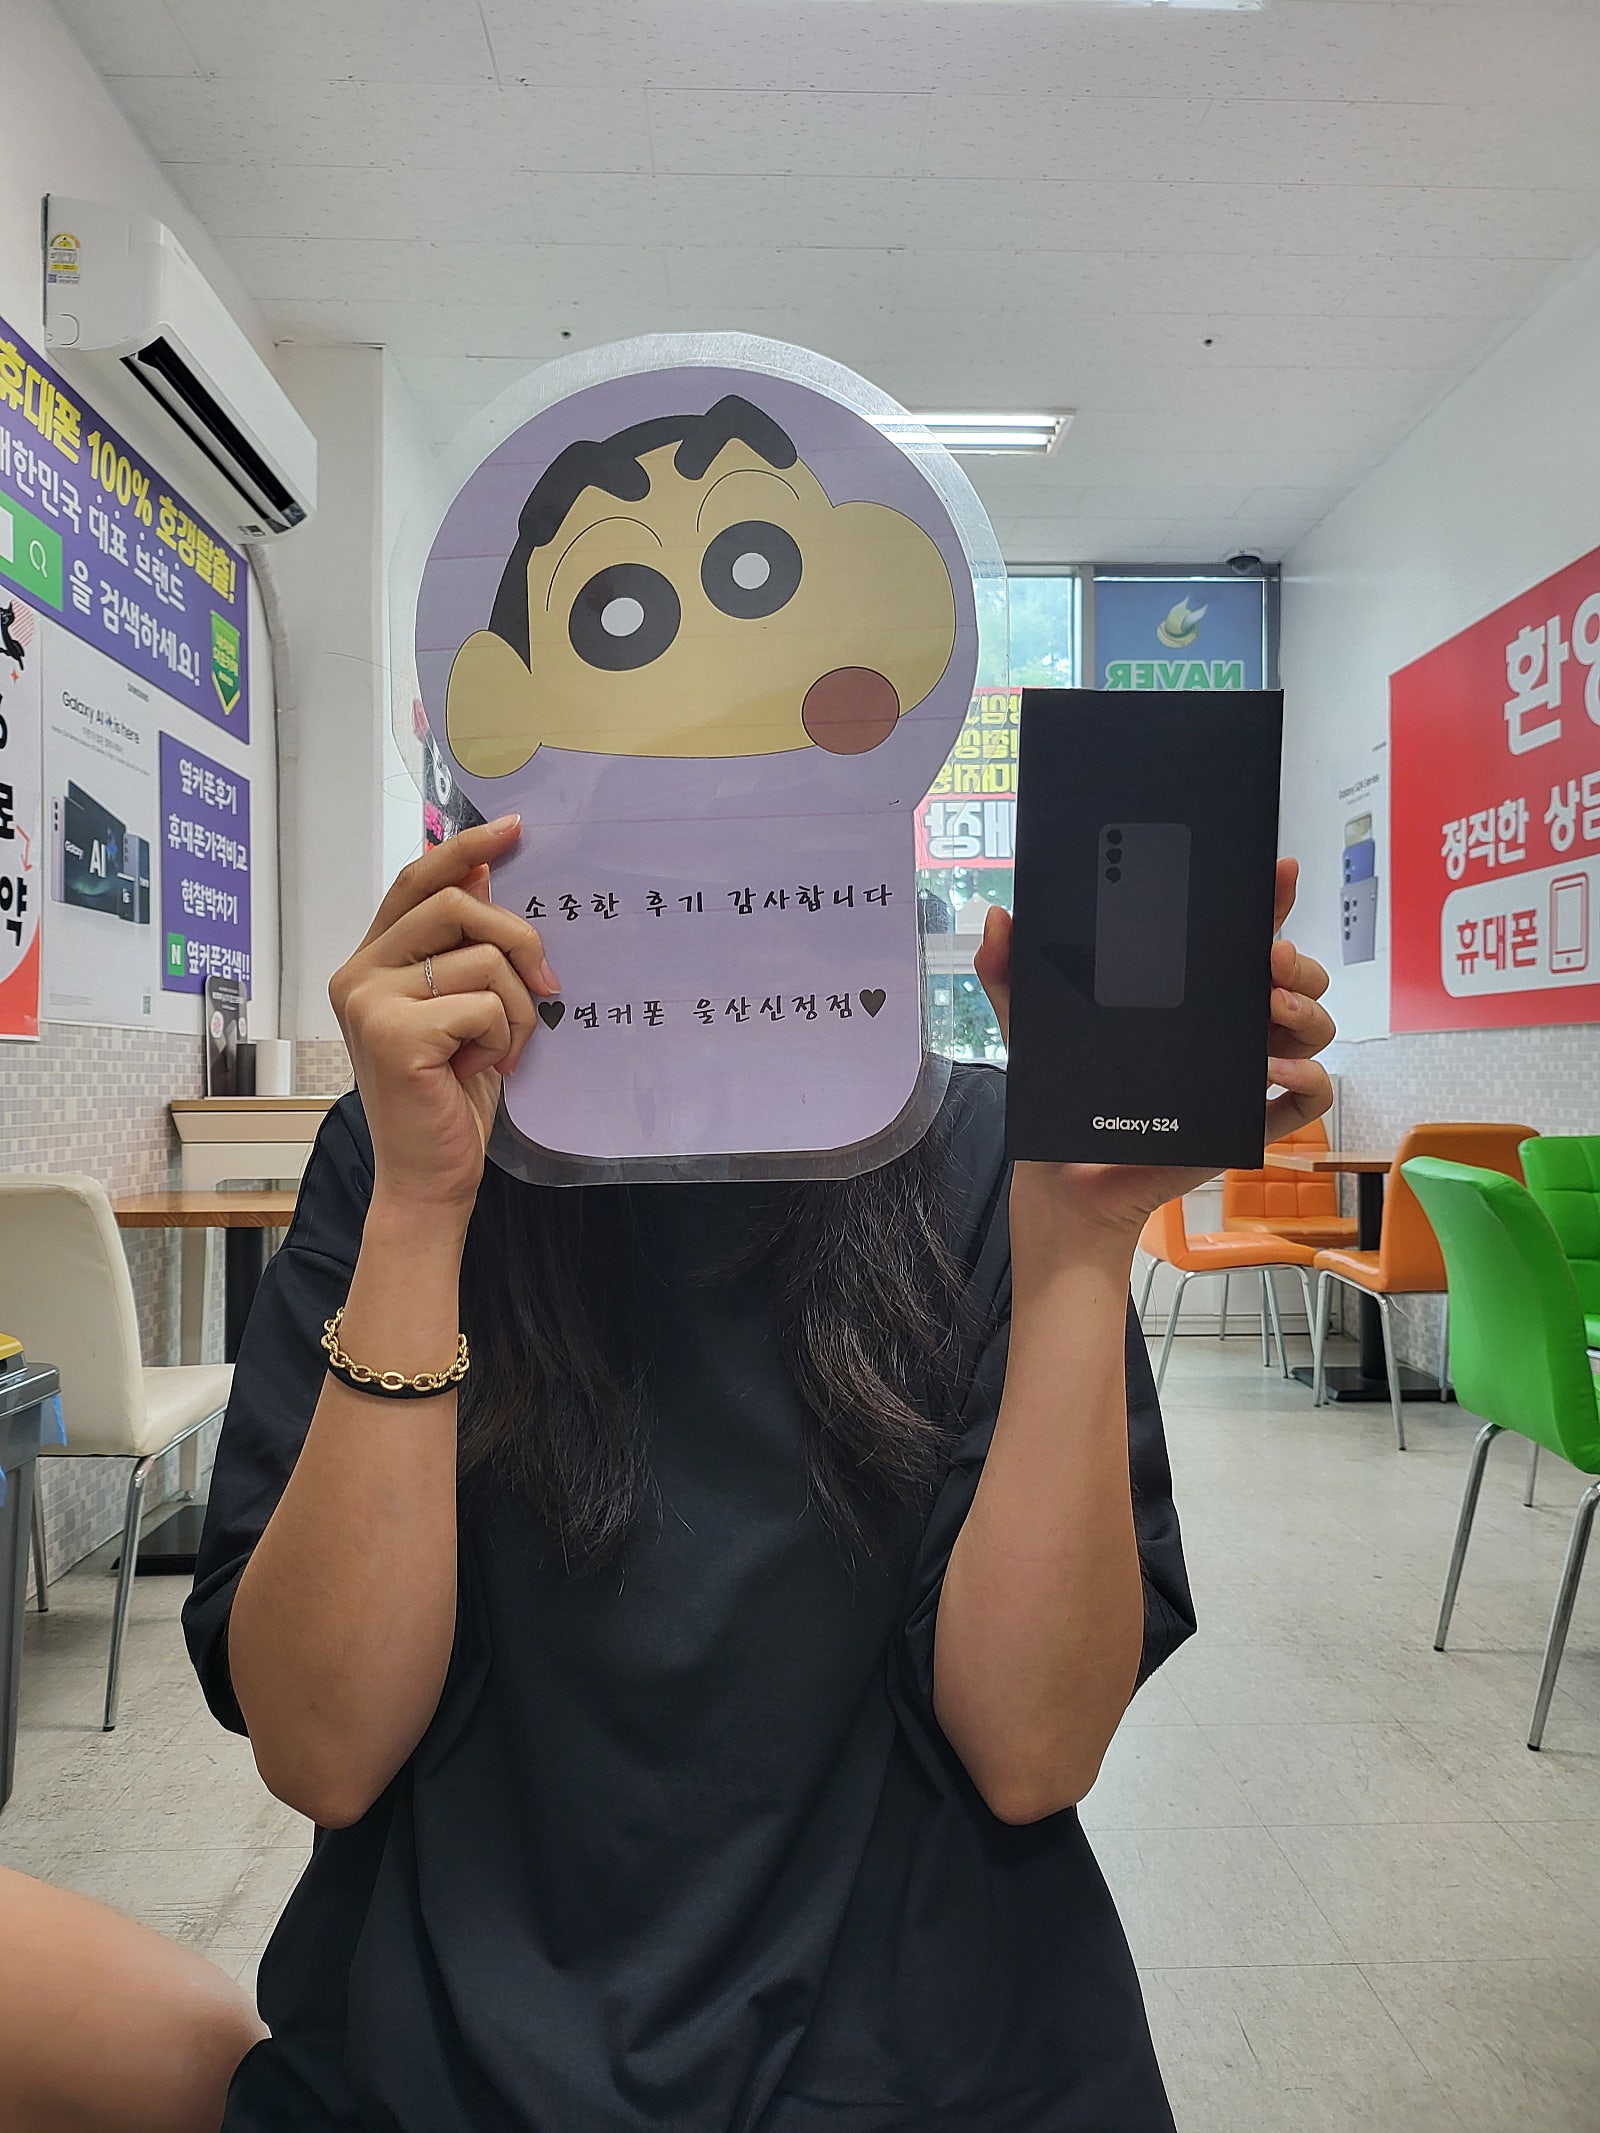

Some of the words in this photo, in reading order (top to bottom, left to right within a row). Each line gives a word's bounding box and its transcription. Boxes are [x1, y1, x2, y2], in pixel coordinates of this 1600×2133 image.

[0, 337, 81, 464] 휴대폰
[87, 430, 153, 527] 100%
[89, 500, 129, 567] 대표
[134, 540, 186, 612] 브랜드
[69, 559, 93, 615] 을
[100, 580, 200, 686] 검색하세요!
[62, 691, 94, 724] Galaxy
[179, 758, 237, 815] 옆커폰후기
[89, 838, 106, 878] AI
[167, 813, 248, 871] 휴대폰가격비교
[1441, 797, 1529, 881] 정직한
[181, 878, 238, 925] 현찰박치기
[525, 892, 620, 921] 소중한
[645, 890, 704, 917] 후기
[727, 884, 894, 917] 감사합니다
[171, 943, 182, 966] N
[1456, 908, 1538, 976] 휴대폰
[573, 1000, 666, 1030] 옆커폰
[692, 993, 854, 1026] 울산신정점
[1092, 1116, 1150, 1135] Galaxy
[1152, 1117, 1180, 1132] S24
